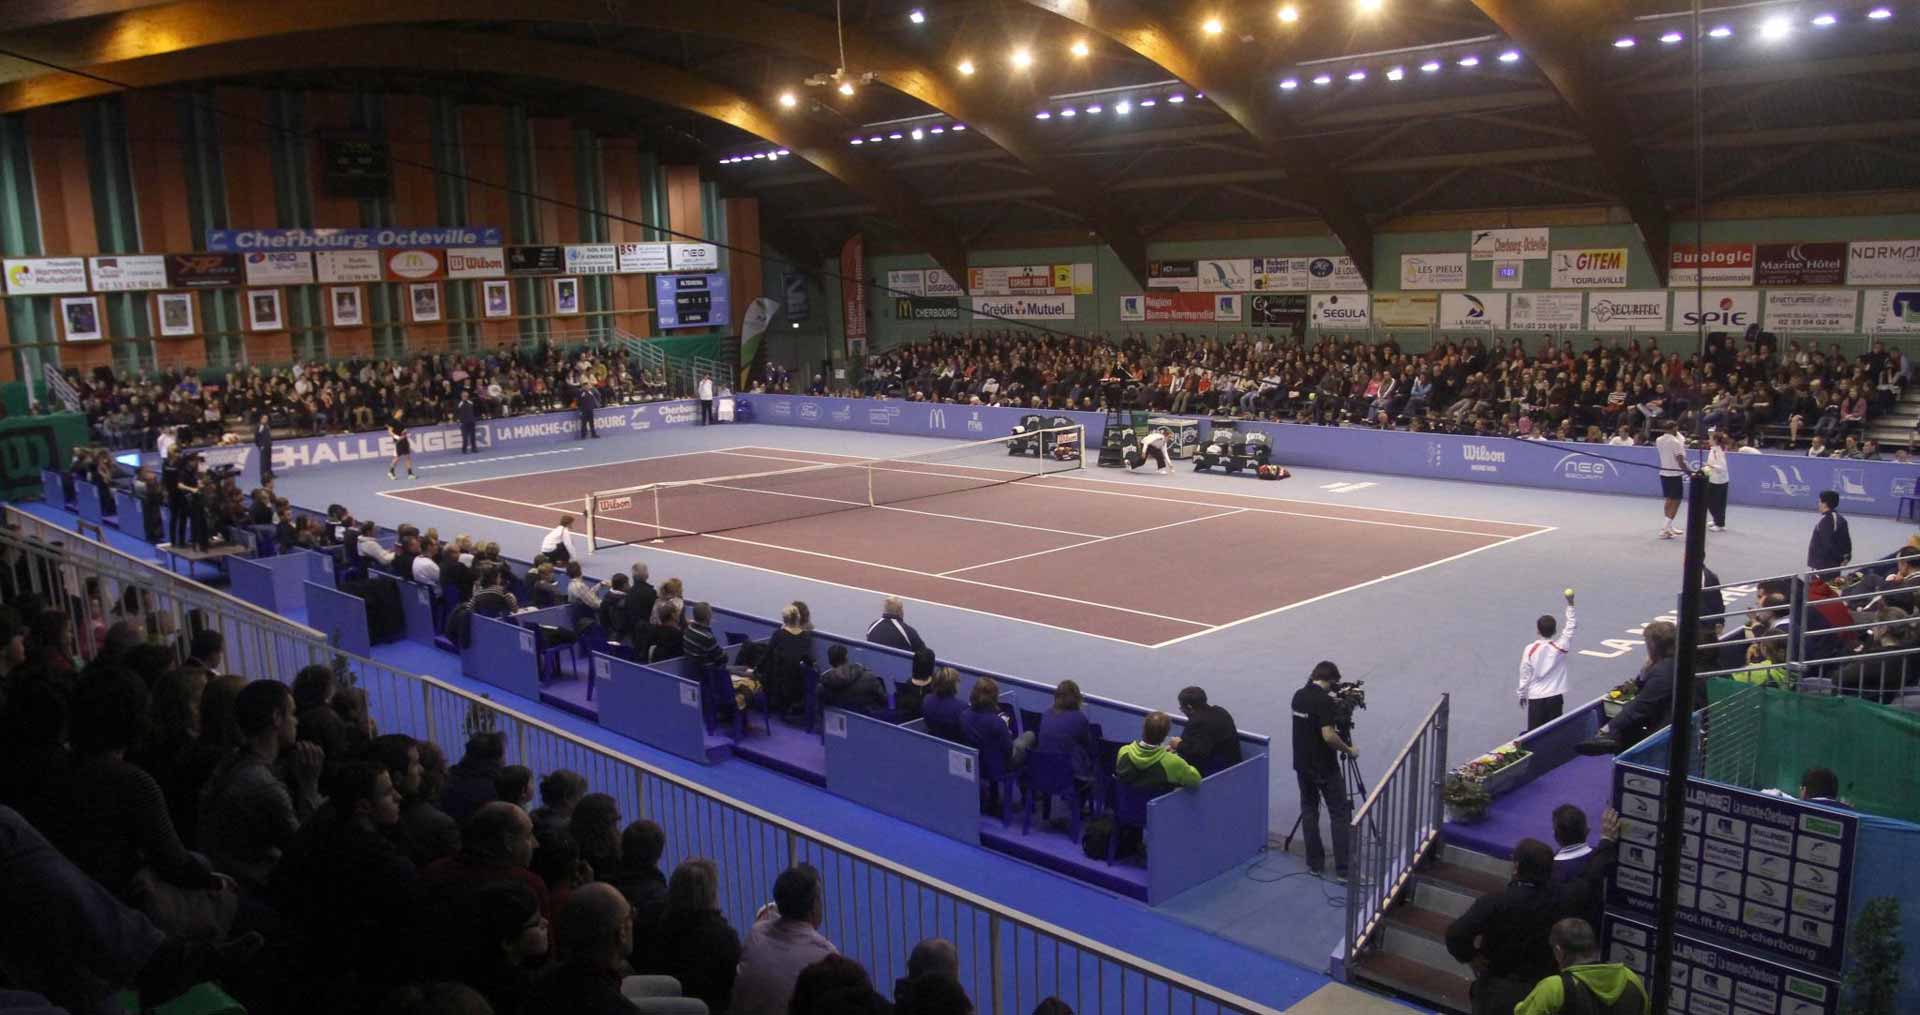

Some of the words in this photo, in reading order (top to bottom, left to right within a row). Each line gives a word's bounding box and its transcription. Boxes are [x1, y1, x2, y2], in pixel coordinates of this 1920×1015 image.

[235, 231, 369, 250] Cherbourg
[377, 230, 477, 246] Octeville
[466, 256, 503, 270] Wilson
[1418, 263, 1433, 274] LES
[1435, 262, 1463, 273] PIEUX
[1576, 252, 1621, 271] GITEM
[1760, 261, 1803, 270] Marine
[1806, 259, 1840, 270] Hôtel
[1571, 276, 1624, 285] TOURLAVILLE
[982, 302, 1013, 315] Crédit
[1027, 302, 1065, 315] Mutuel
[1322, 308, 1367, 319] SEGULA
[497, 424, 512, 441] LA
[1463, 445, 1506, 463] Wilson
[600, 500, 630, 510] Wilson
